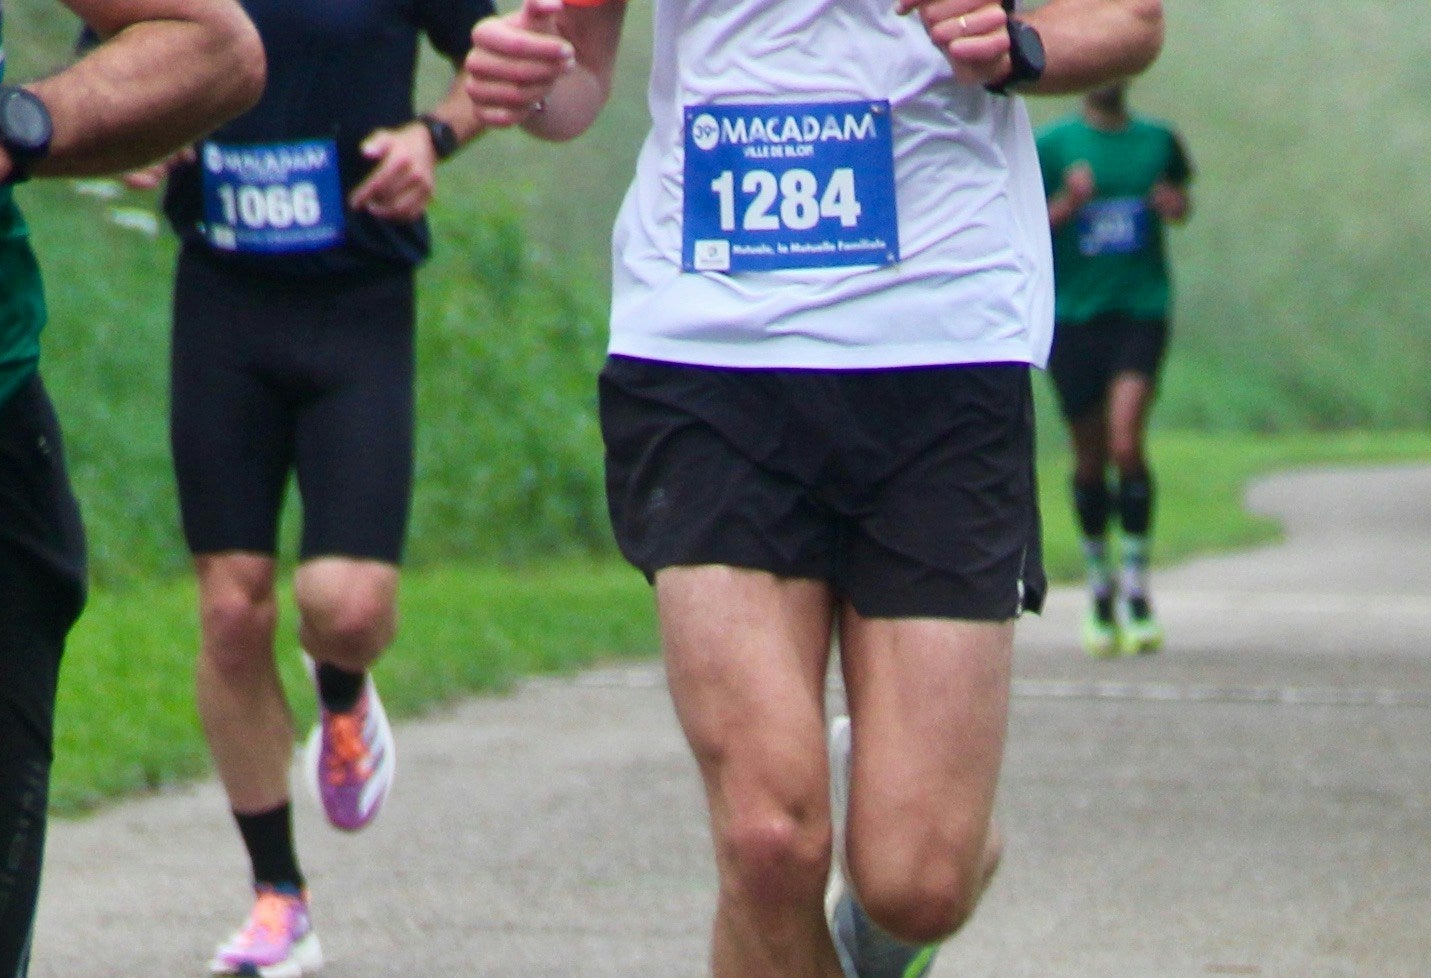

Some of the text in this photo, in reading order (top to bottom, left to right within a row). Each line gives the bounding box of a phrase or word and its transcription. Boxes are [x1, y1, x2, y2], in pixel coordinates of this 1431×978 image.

[720, 113, 877, 144] MACADAM
[219, 180, 321, 229] 1066
[711, 166, 862, 231] 1284
